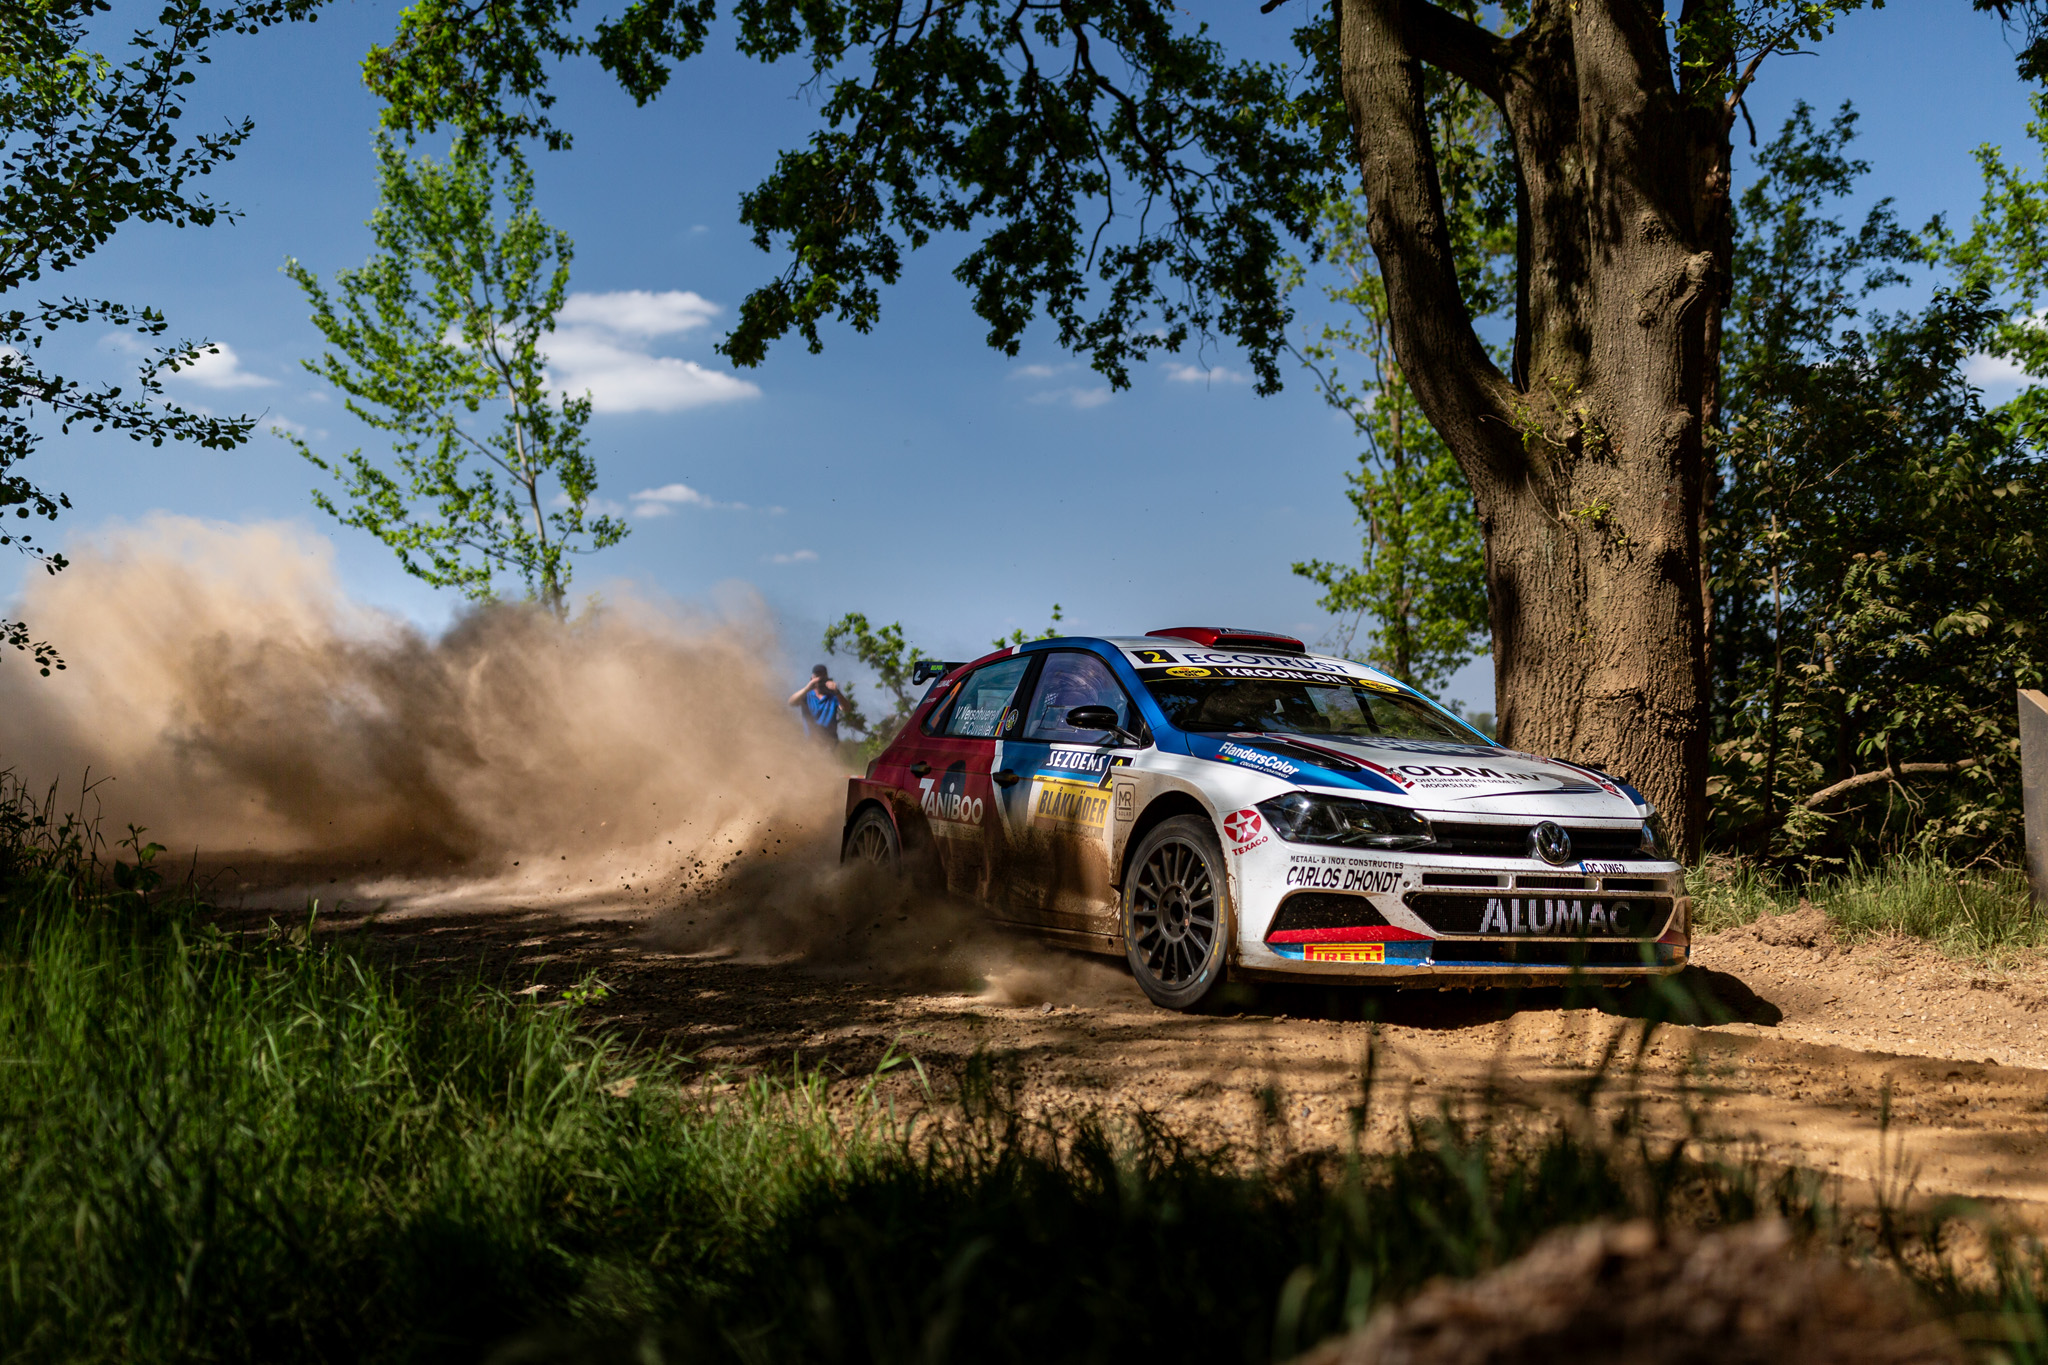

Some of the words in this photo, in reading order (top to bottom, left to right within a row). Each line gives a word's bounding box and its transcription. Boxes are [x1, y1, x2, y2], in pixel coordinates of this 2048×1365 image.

[1143, 651, 1168, 663] 2
[1182, 653, 1349, 674] ECOTRUST
[1225, 668, 1348, 684] KROON-OIL
[1046, 750, 1107, 772] SEZOENS
[1219, 741, 1300, 775] FlandersColor
[1263, 767, 1290, 779] COATINGS
[1398, 765, 1505, 779] ODM
[1505, 772, 1540, 782] NV
[1039, 786, 1107, 824] BLÅKLÄDER
[1118, 791, 1132, 807] MR
[1232, 836, 1268, 856] TEXACO
[1321, 856, 1327, 864] &
[1328, 857, 1346, 865] INOX
[1348, 858, 1404, 869] CONSTRUCTIES
[1286, 866, 1342, 888] CARLOS
[1343, 869, 1403, 893] DHONDT
[1479, 899, 1630, 934] ALUMAC
[1305, 944, 1383, 961] PIRELLI
